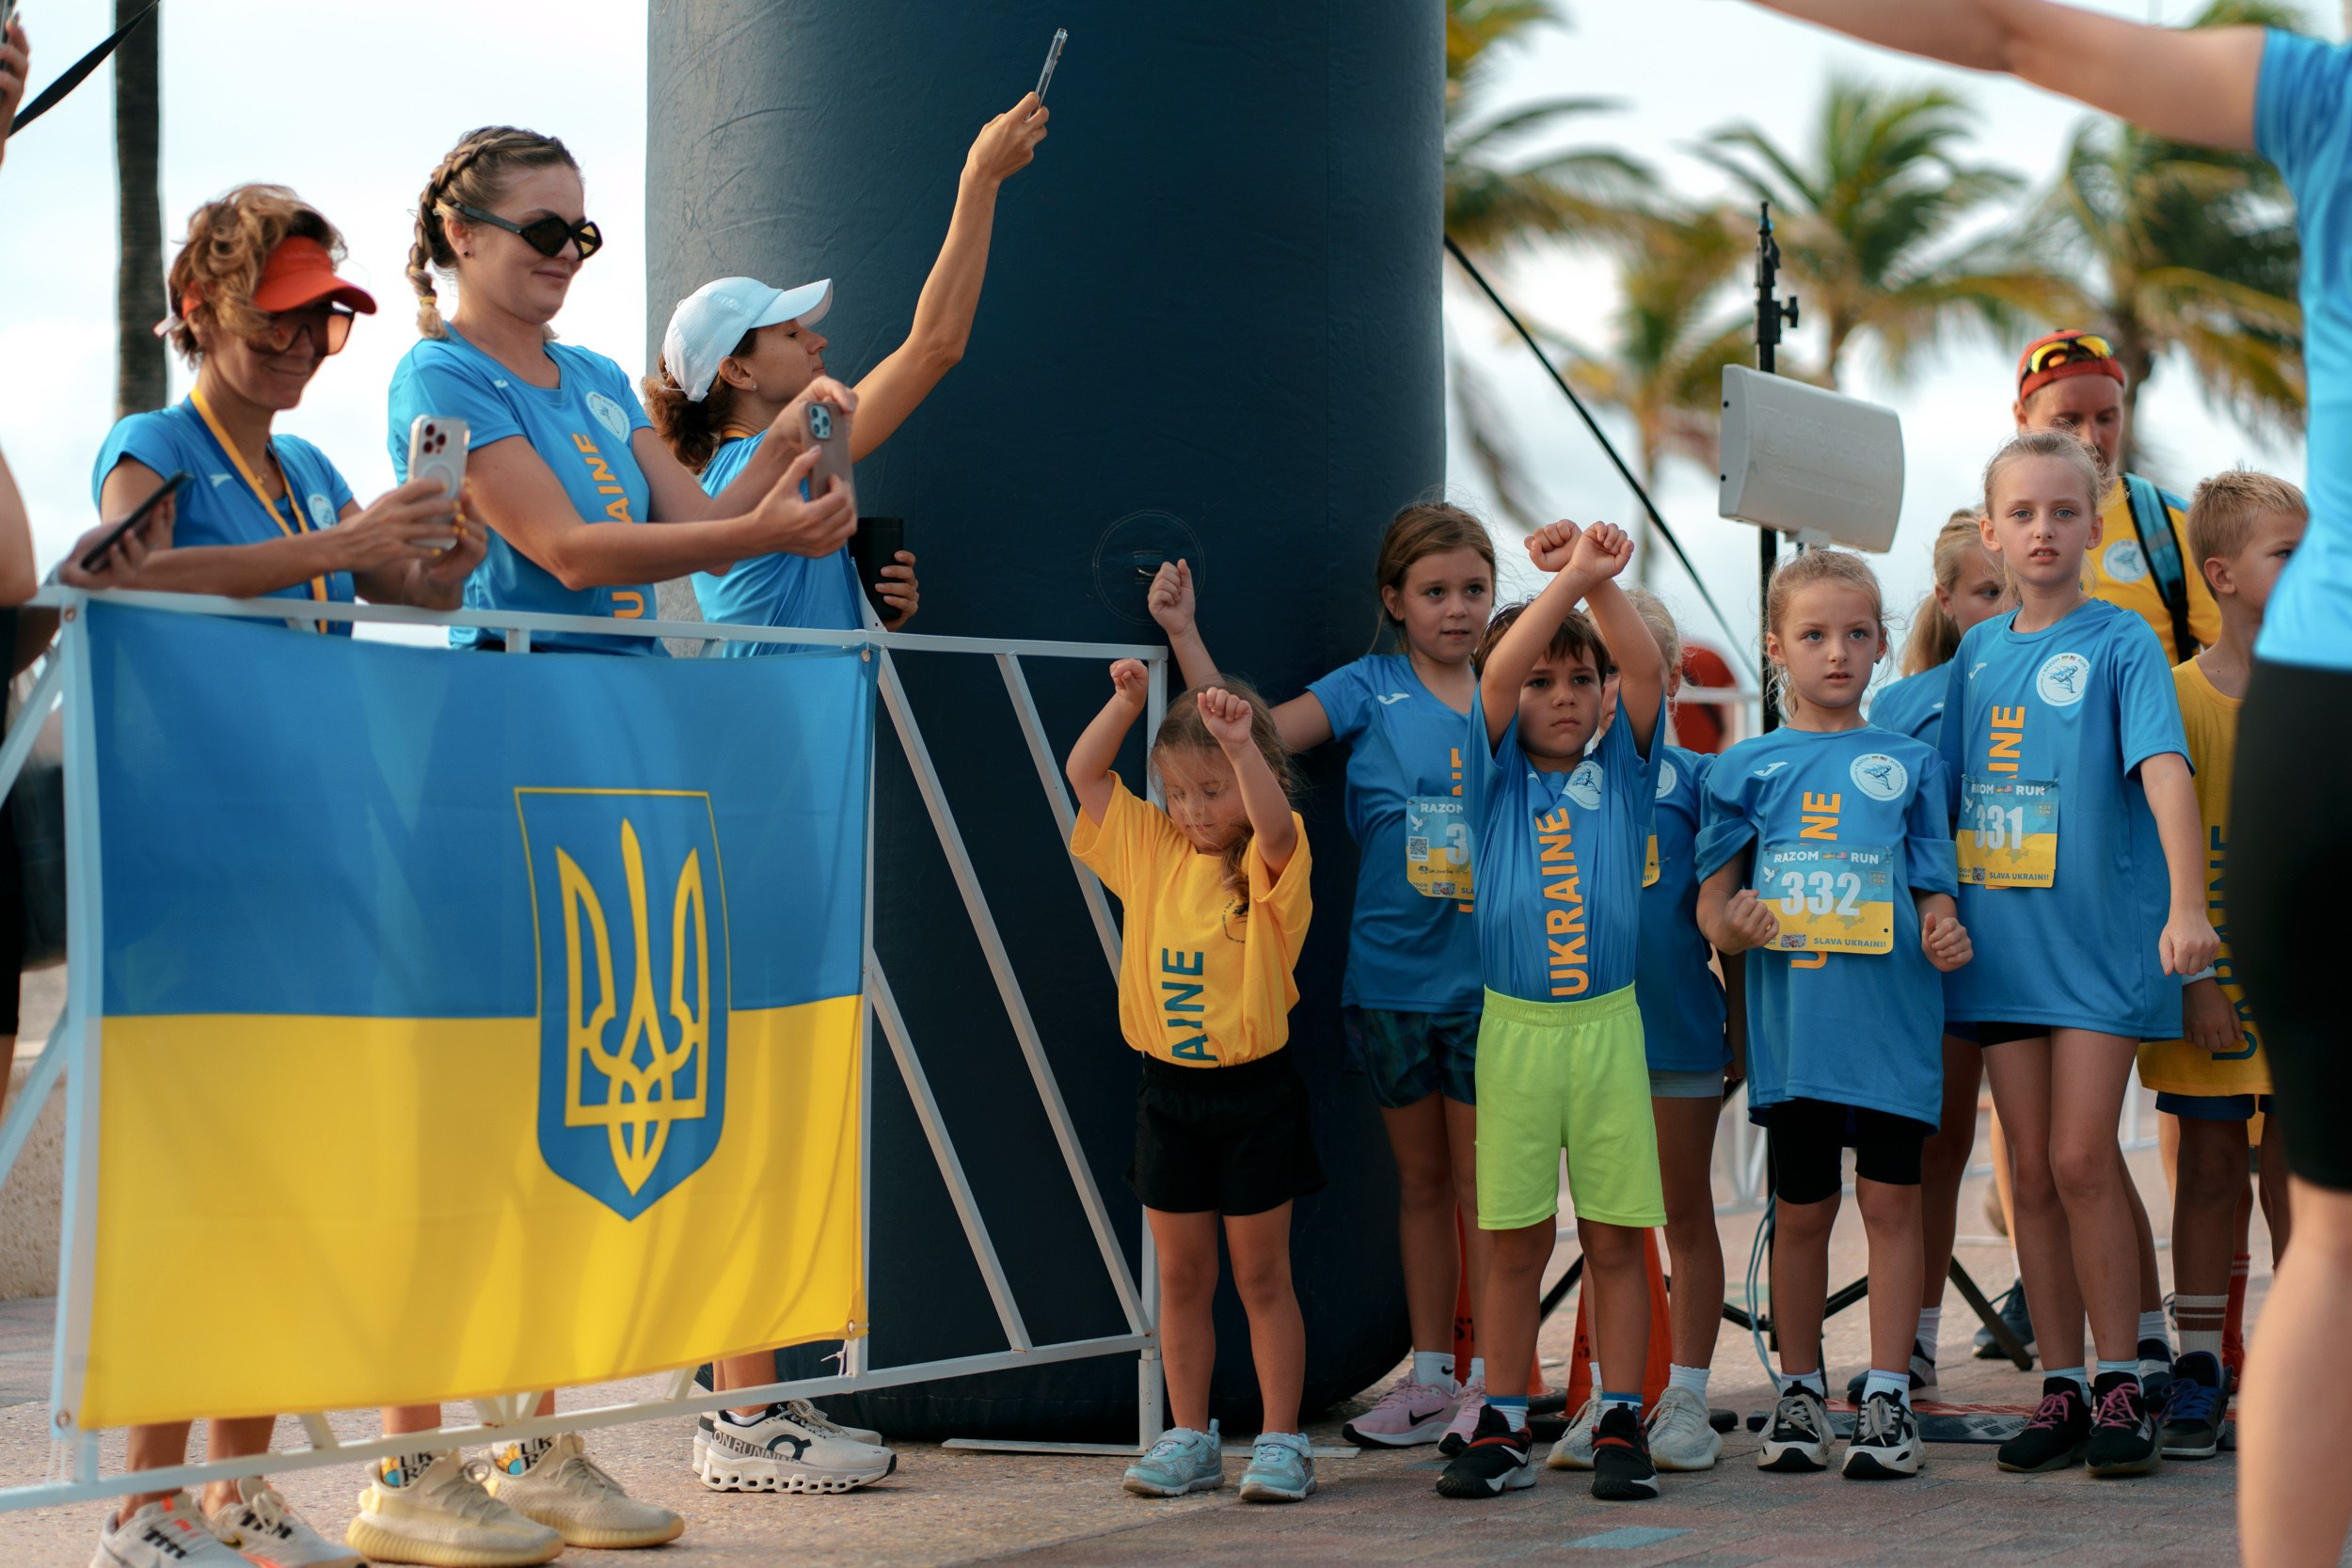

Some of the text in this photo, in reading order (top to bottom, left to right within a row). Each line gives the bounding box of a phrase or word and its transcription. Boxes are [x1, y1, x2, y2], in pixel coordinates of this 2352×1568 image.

[572, 433, 644, 619] UAINE
[2015, 784, 2045, 796] RUN
[1975, 803, 2024, 850] 331
[1773, 850, 1879, 864] RAZOM RUN
[1989, 871, 2010, 879] SLAVA
[1534, 807, 1590, 997] UKRAINE
[1781, 870, 1862, 916] 332
[1813, 937, 1842, 946] SLAVA
[713, 1430, 731, 1449] ON
